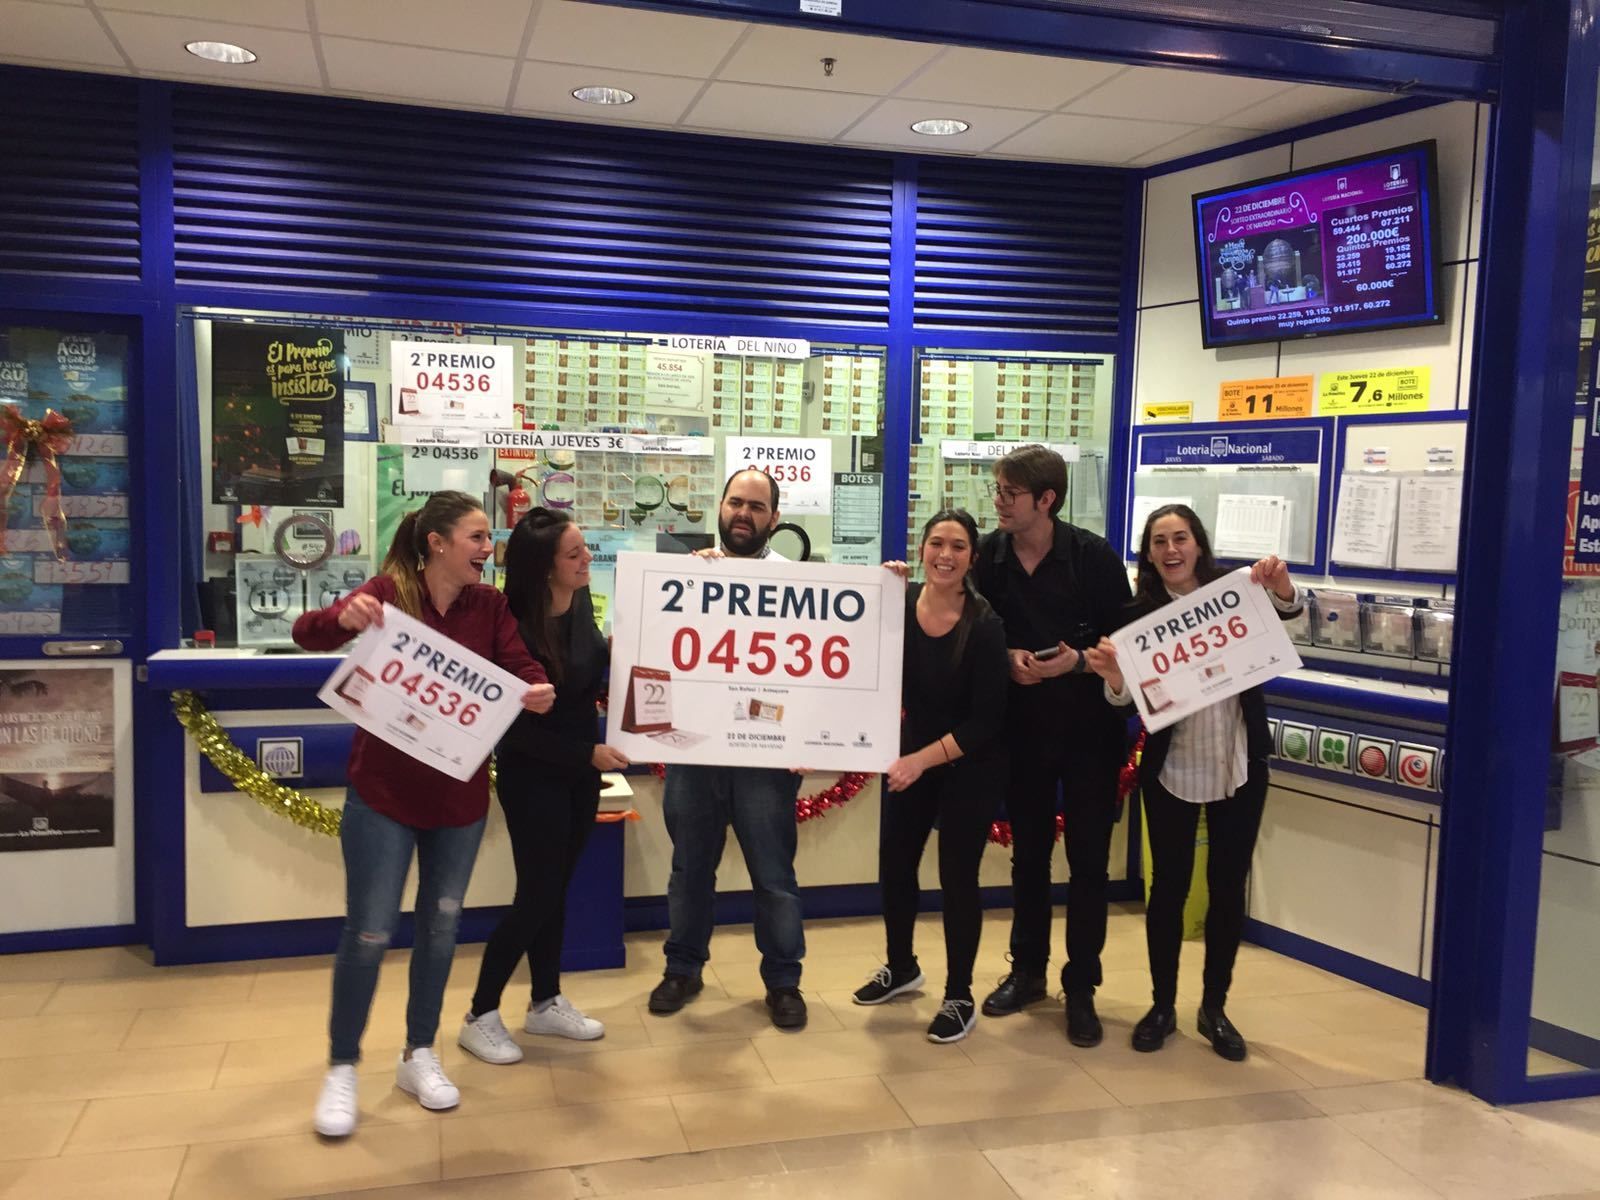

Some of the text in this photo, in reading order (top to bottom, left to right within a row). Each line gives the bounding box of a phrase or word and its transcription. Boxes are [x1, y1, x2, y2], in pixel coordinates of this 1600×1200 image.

[1243, 204, 1251, 213] DE
[1252, 196, 1286, 211] DICIEMBRE
[1331, 205, 1414, 226] Cuartos Premios
[1381, 215, 1410, 226] 07.211
[1337, 236, 1411, 253] Quintos Premios
[1346, 227, 1399, 245] 200.000€
[1385, 244, 1411, 254] 19.152
[1356, 280, 1394, 294] 60.000€
[1226, 318, 1250, 327] Quinto
[1251, 315, 1276, 325] premio
[1278, 316, 1331, 329] muy repartido
[286, 338, 333, 362] Premio
[672, 336, 726, 352] LOTERÍA
[737, 340, 761, 352] DEL
[278, 364, 302, 379] para
[303, 358, 318, 373] los
[318, 359, 337, 377] que
[427, 353, 495, 370] PREMIO
[271, 374, 337, 403] insisten
[416, 371, 491, 392] 04536
[1388, 392, 1424, 402] Millones
[486, 432, 624, 449] LOTERÍA JUEVES 3€
[1228, 443, 1272, 455] Nacional
[433, 446, 479, 460] 04536
[757, 447, 816, 461] PREMIO
[988, 445, 1007, 456] DEL
[841, 474, 874, 484] BOTES
[257, 591, 278, 607] 11
[661, 579, 865, 622] 2º PREMIO
[1152, 590, 1241, 643] PREMIO
[672, 626, 850, 680] 04536
[1152, 614, 1249, 675] 04536
[413, 642, 503, 703] PREMIO
[379, 659, 482, 727] 04536
[644, 683, 665, 702] 22
[737, 732, 746, 740] DE
[748, 733, 786, 742] DICIEMBRE
